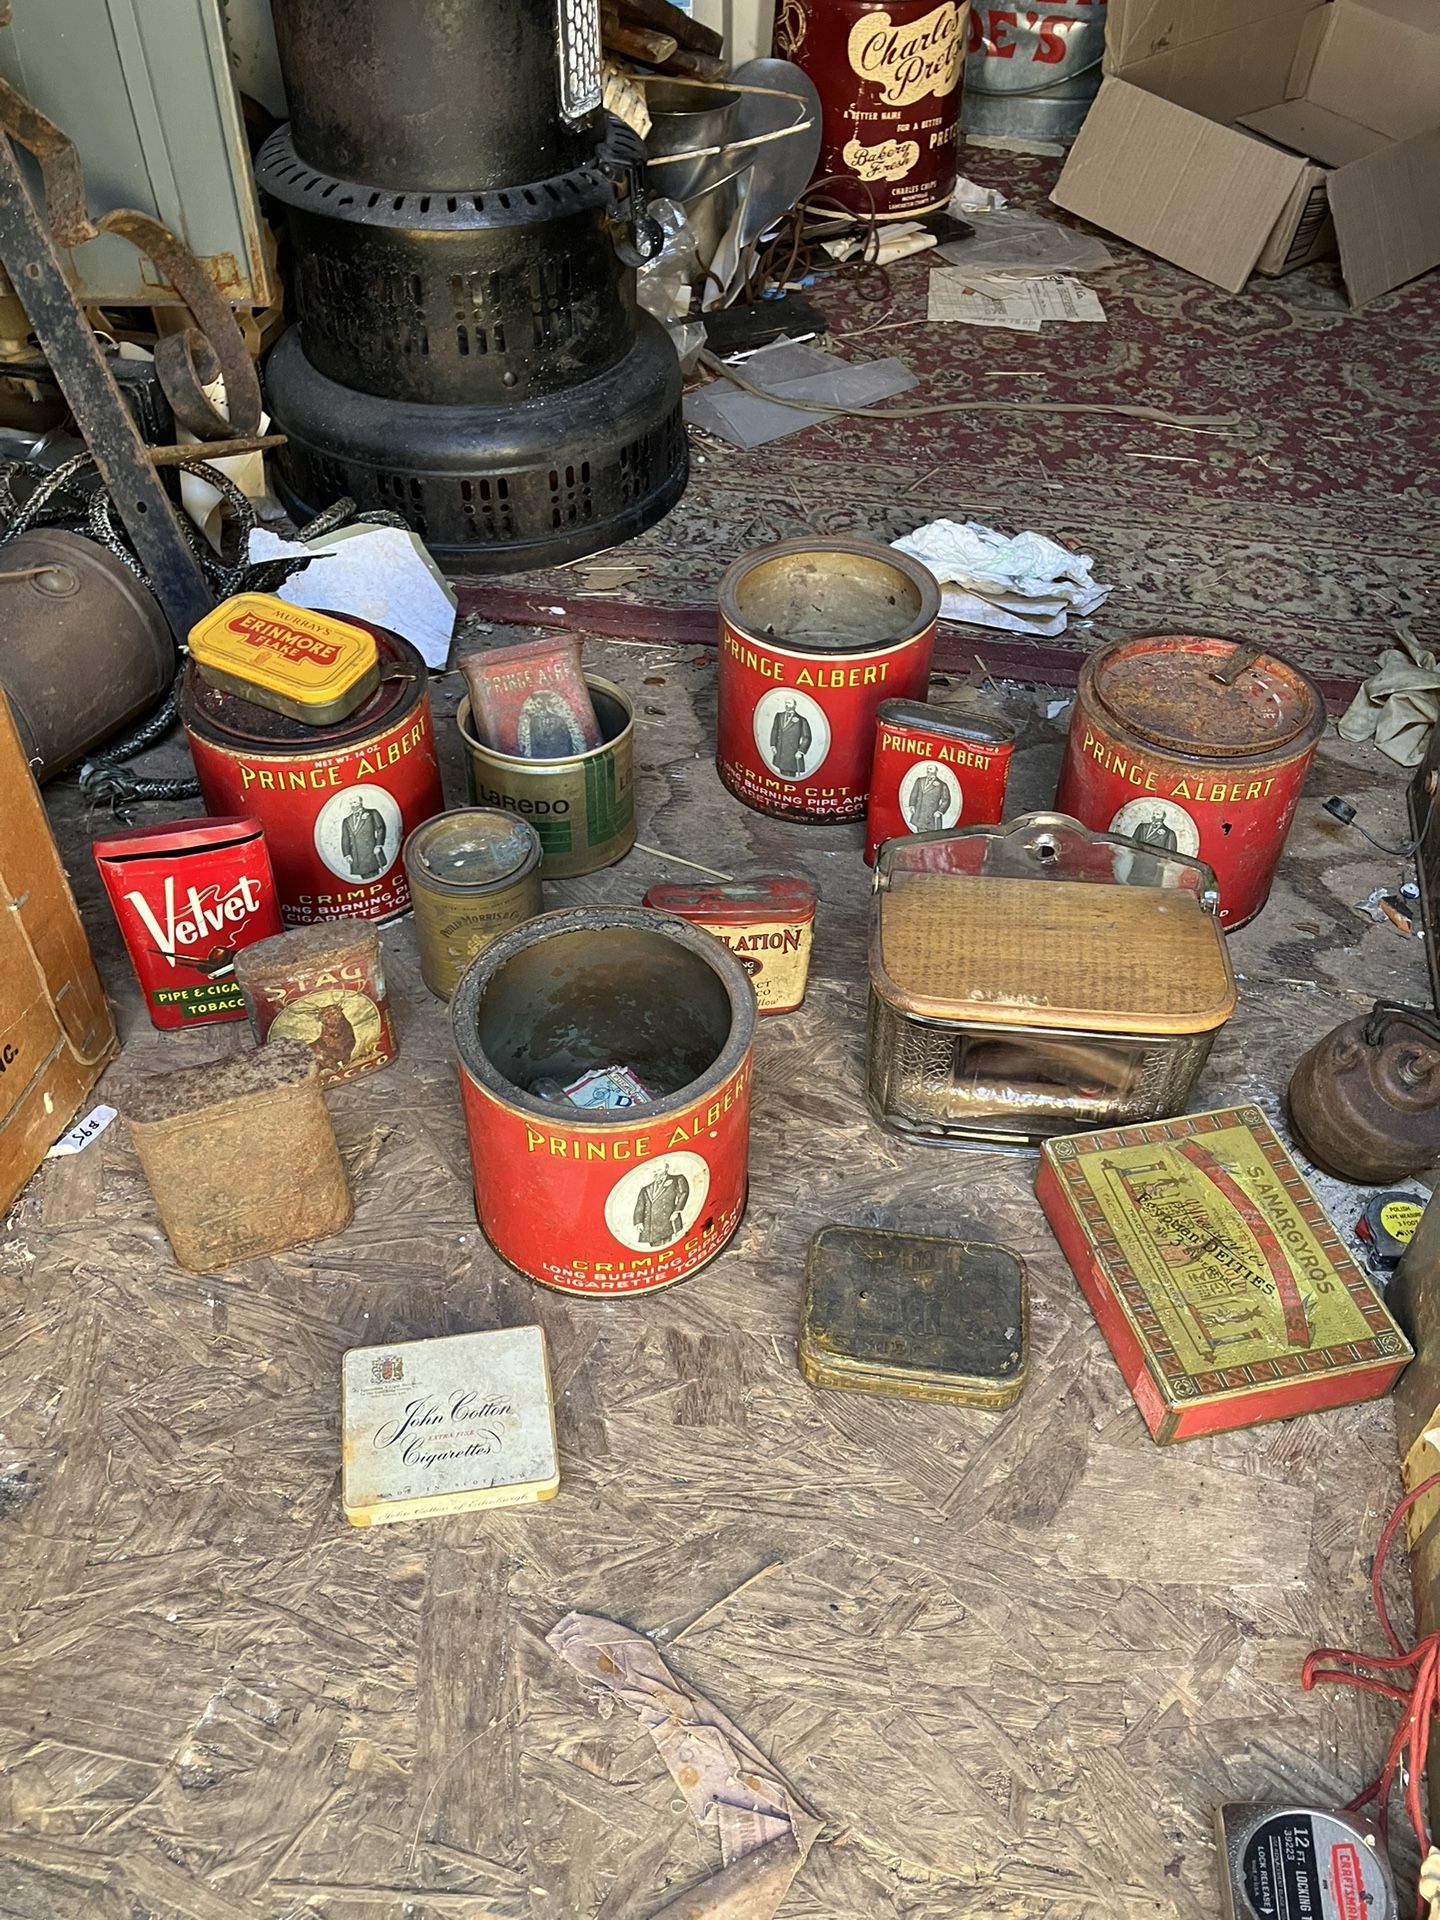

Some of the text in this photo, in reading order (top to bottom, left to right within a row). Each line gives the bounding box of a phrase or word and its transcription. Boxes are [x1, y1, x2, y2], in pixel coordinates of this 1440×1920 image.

[861, 10, 959, 71] Charles
[851, 143, 911, 167] Bakery
[865, 159, 910, 177] Fresh
[239, 616, 337, 659] ERINMORE
[272, 608, 334, 636] MURRAY'S
[254, 635, 301, 657] FLAKE
[796, 662, 890, 688] ALBERT
[237, 715, 426, 790] PRINCE ALBERT
[314, 760, 333, 769] NET
[334, 755, 353, 764] WT.
[354, 750, 365, 759] 14
[882, 732, 992, 771] PRINCE ALBERT
[1083, 731, 1276, 802] PRINCE ALBERT
[734, 761, 852, 797] CRIMP CUT
[744, 779, 802, 805] BURNING
[807, 798, 838, 807] PIPE
[794, 803, 864, 816] OBACCO
[298, 884, 384, 905] CRIMP
[318, 892, 392, 914] BURNING
[123, 875, 262, 967] Velvet
[158, 990, 189, 1002] PIPE
[193, 987, 205, 998] &
[263, 966, 363, 1003] STAG
[322, 1055, 389, 1085] ACCO
[525, 1065, 749, 1161] PRINCE ALBERT
[542, 1262, 586, 1279] LONG
[594, 1257, 683, 1281] BURNING
[688, 1231, 719, 1258] PIPE
[553, 1215, 737, 1289] CIGARETTE TOBACCO
[571, 1210, 728, 1272] CRIMP CUT
[373, 1389, 512, 1450] John Cotton
[401, 1432, 495, 1470] Cigarettes
[1293, 1827, 1310, 1847] 12
[1257, 1846, 1271, 1908] LOCK RELEASE
[1295, 1871, 1311, 1911] LOCKING
